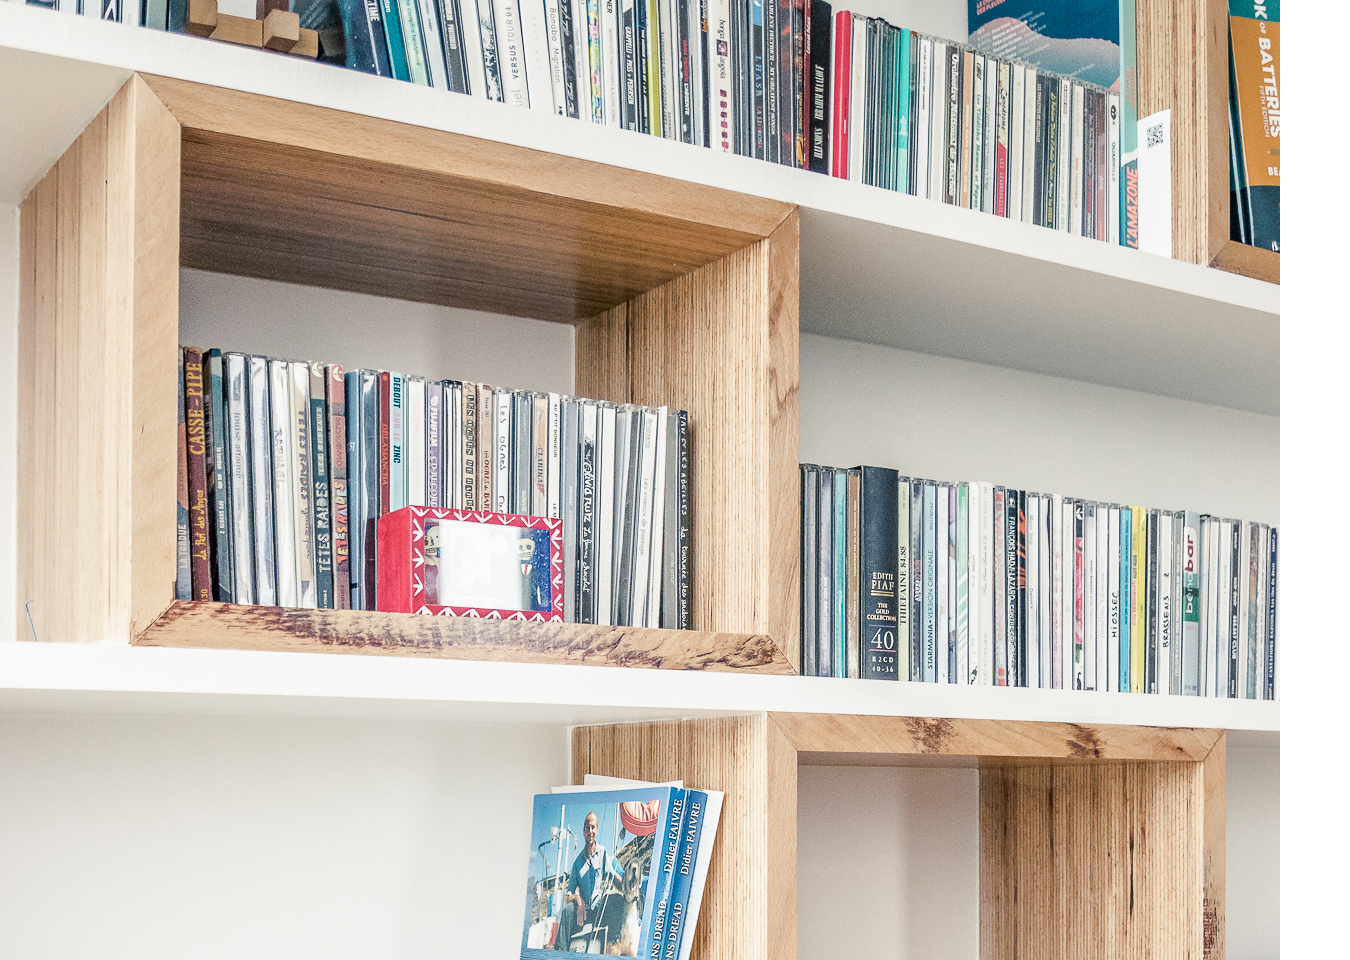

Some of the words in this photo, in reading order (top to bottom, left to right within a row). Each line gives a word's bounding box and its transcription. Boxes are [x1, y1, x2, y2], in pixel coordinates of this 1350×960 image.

[506, 19, 514, 42] TOUR
[549, 8, 558, 41] Bonobo
[1259, 22, 1267, 34] OF
[508, 44, 518, 79] VERSUS
[551, 48, 561, 83] Migration
[1258, 37, 1280, 139] BATTERIES
[1261, 107, 1270, 138] EDITION
[1126, 166, 1138, 249] L'AMAZONE
[392, 377, 400, 408] DEBOUT
[392, 412, 400, 428] SUR
[392, 433, 400, 441] LE
[392, 445, 400, 464] ZINC
[315, 480, 329, 528] RAIDES
[177, 523, 187, 554] TORDUE
[179, 557, 187, 568] LA
[871, 580, 895, 591] PIAF
[866, 613, 897, 622] COLLECTION
[870, 628, 895, 650] 40
[666, 797, 685, 840] FAIVRE
[684, 800, 702, 842] FAIVRE
[662, 841, 677, 873] Didier
[679, 843, 694, 875] Didier
[651, 900, 667, 941] DREAD
[667, 900, 683, 942] DREAD
